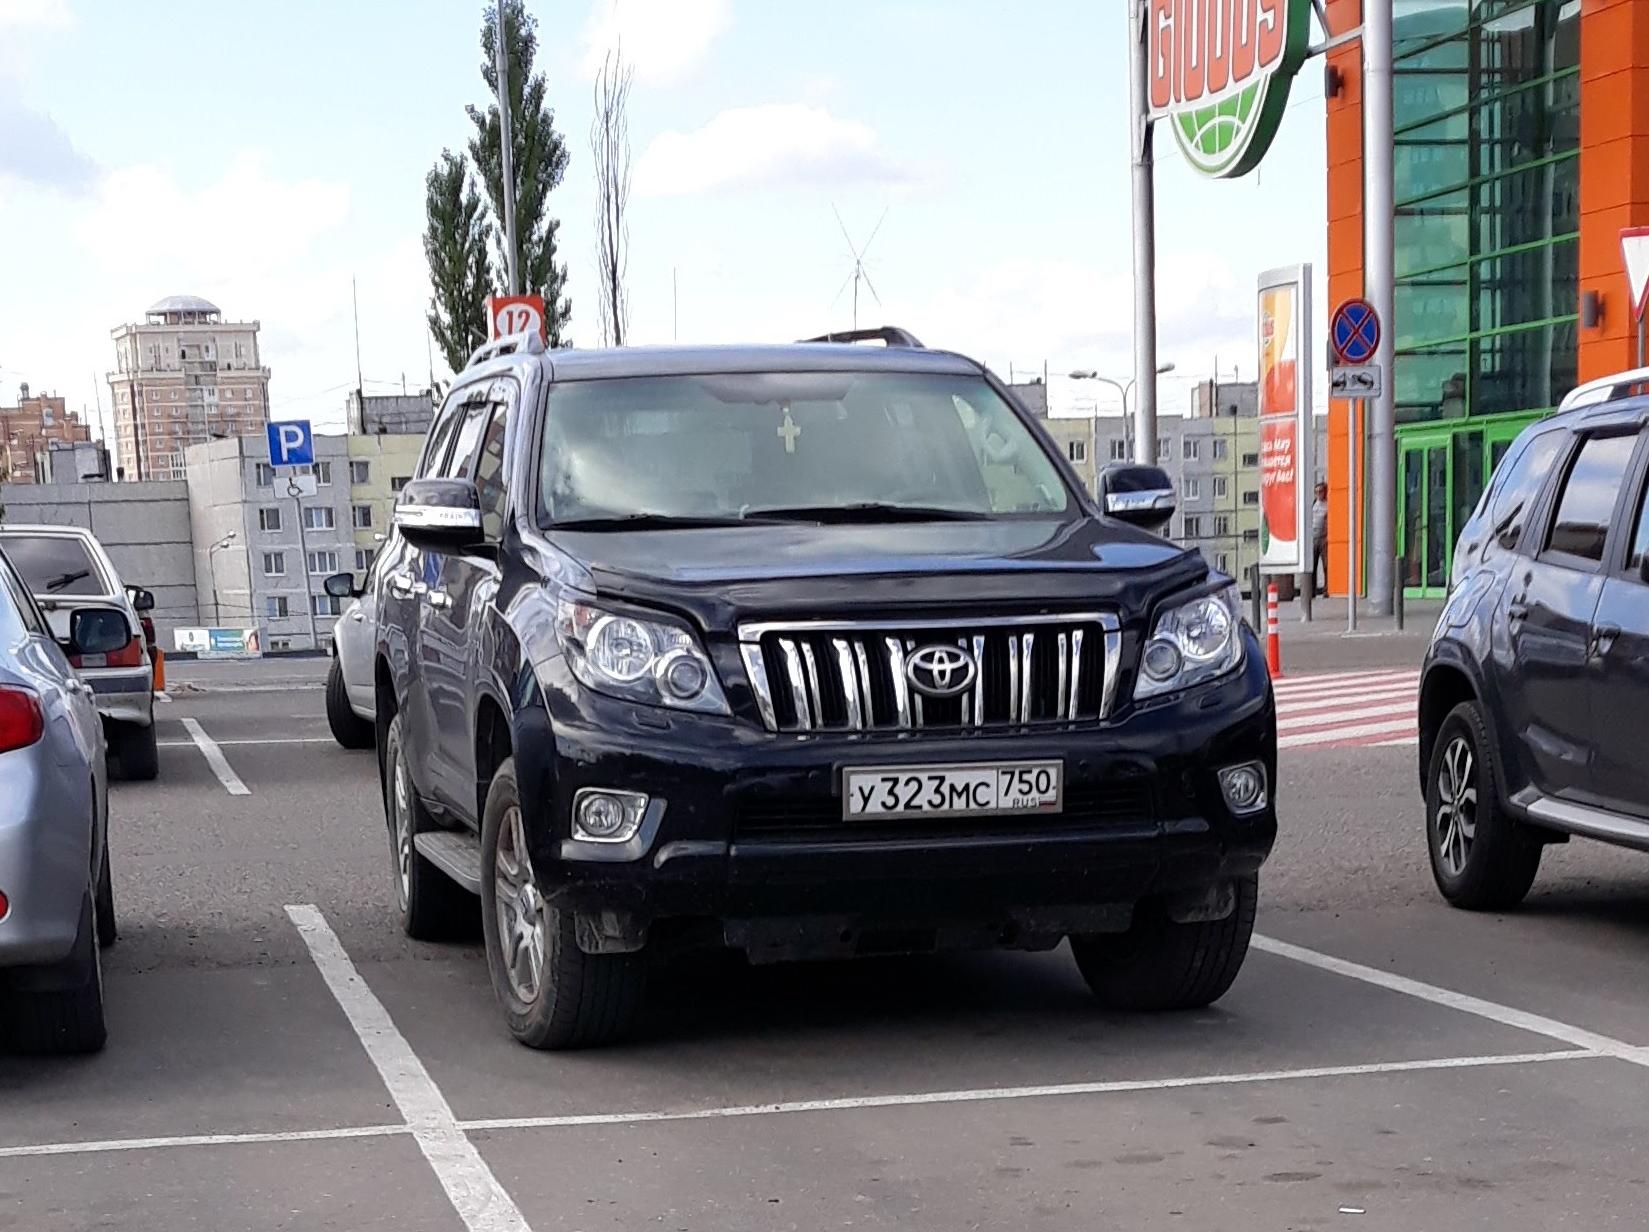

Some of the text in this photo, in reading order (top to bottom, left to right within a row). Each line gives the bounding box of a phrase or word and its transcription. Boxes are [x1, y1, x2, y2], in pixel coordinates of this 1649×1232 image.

[507, 309, 531, 335] 12
[279, 425, 304, 462] P
[1001, 769, 1051, 797] 750
[1012, 797, 1038, 808] RUS
